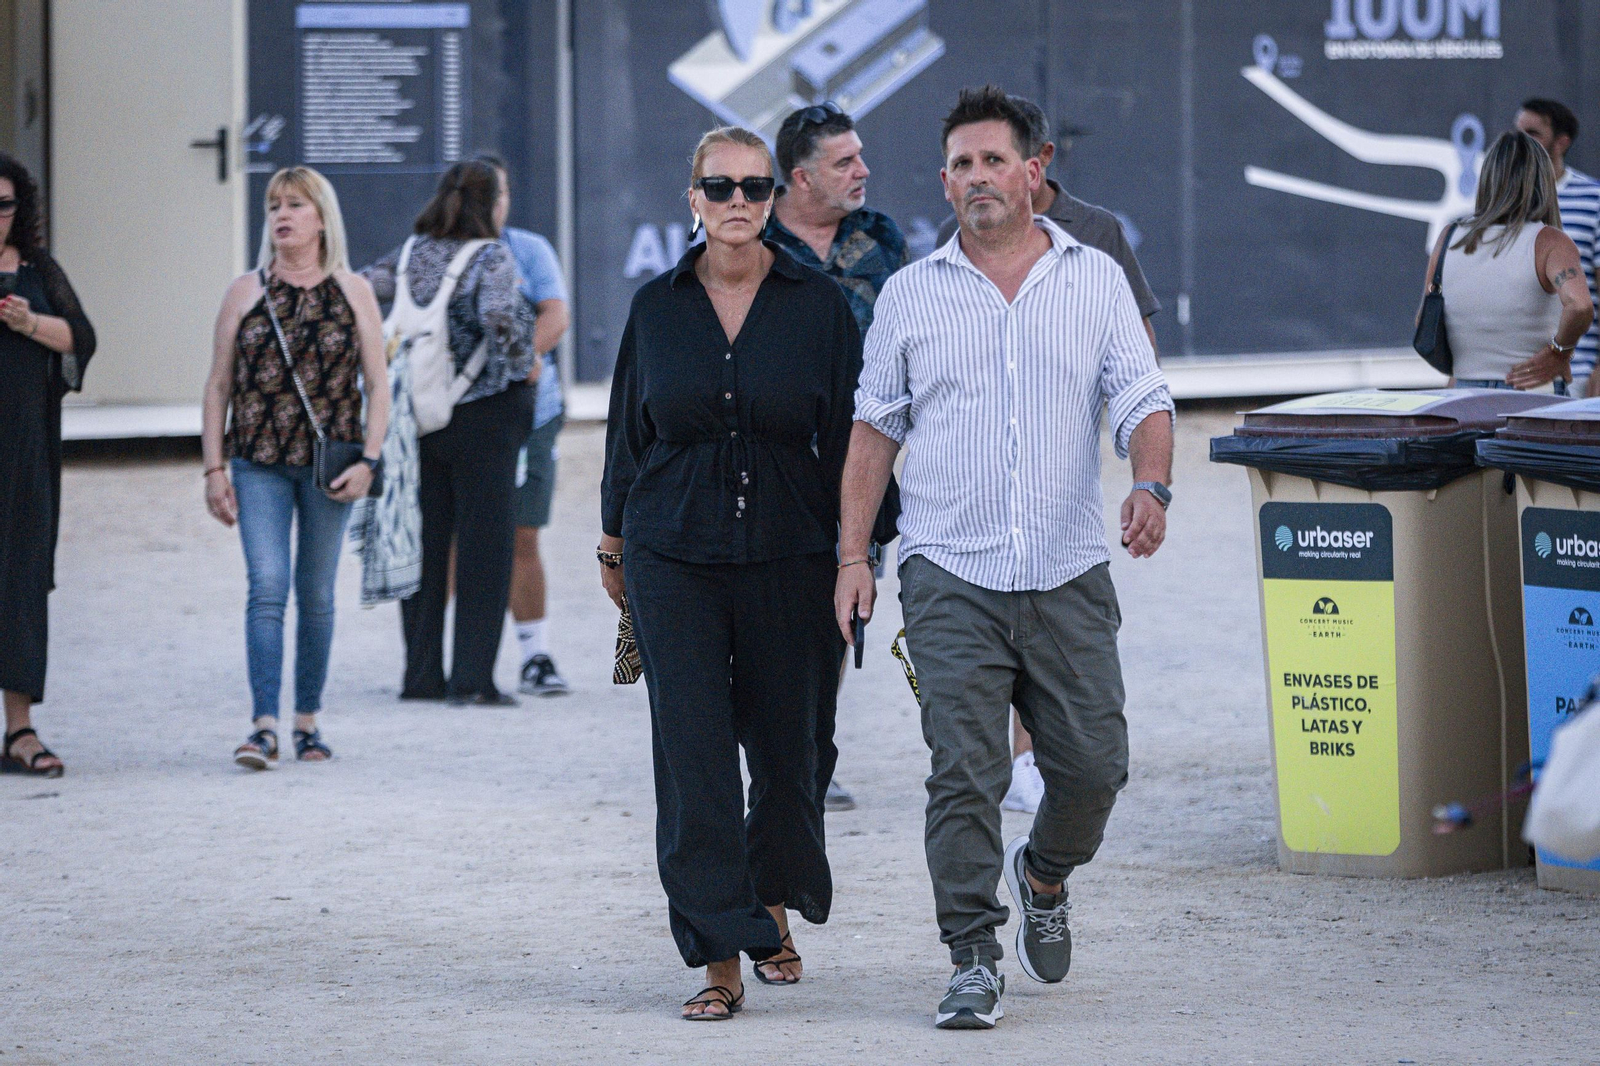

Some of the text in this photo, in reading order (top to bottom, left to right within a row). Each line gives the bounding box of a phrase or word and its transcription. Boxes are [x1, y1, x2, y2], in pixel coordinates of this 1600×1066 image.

[1297, 525, 1374, 548] urbaser
[1556, 534, 1600, 557] urba
[1298, 550, 1361, 559] making circularity real
[1556, 558, 1576, 568] making
[1556, 627, 1584, 635] CONCERT
[1568, 641, 1595, 650] EARTH
[1283, 673, 1379, 690] ENVASES DE
[1291, 692, 1372, 714] PLÁSTICO,
[1301, 718, 1363, 734] LATAS Y
[1310, 741, 1356, 757] BRIKS
